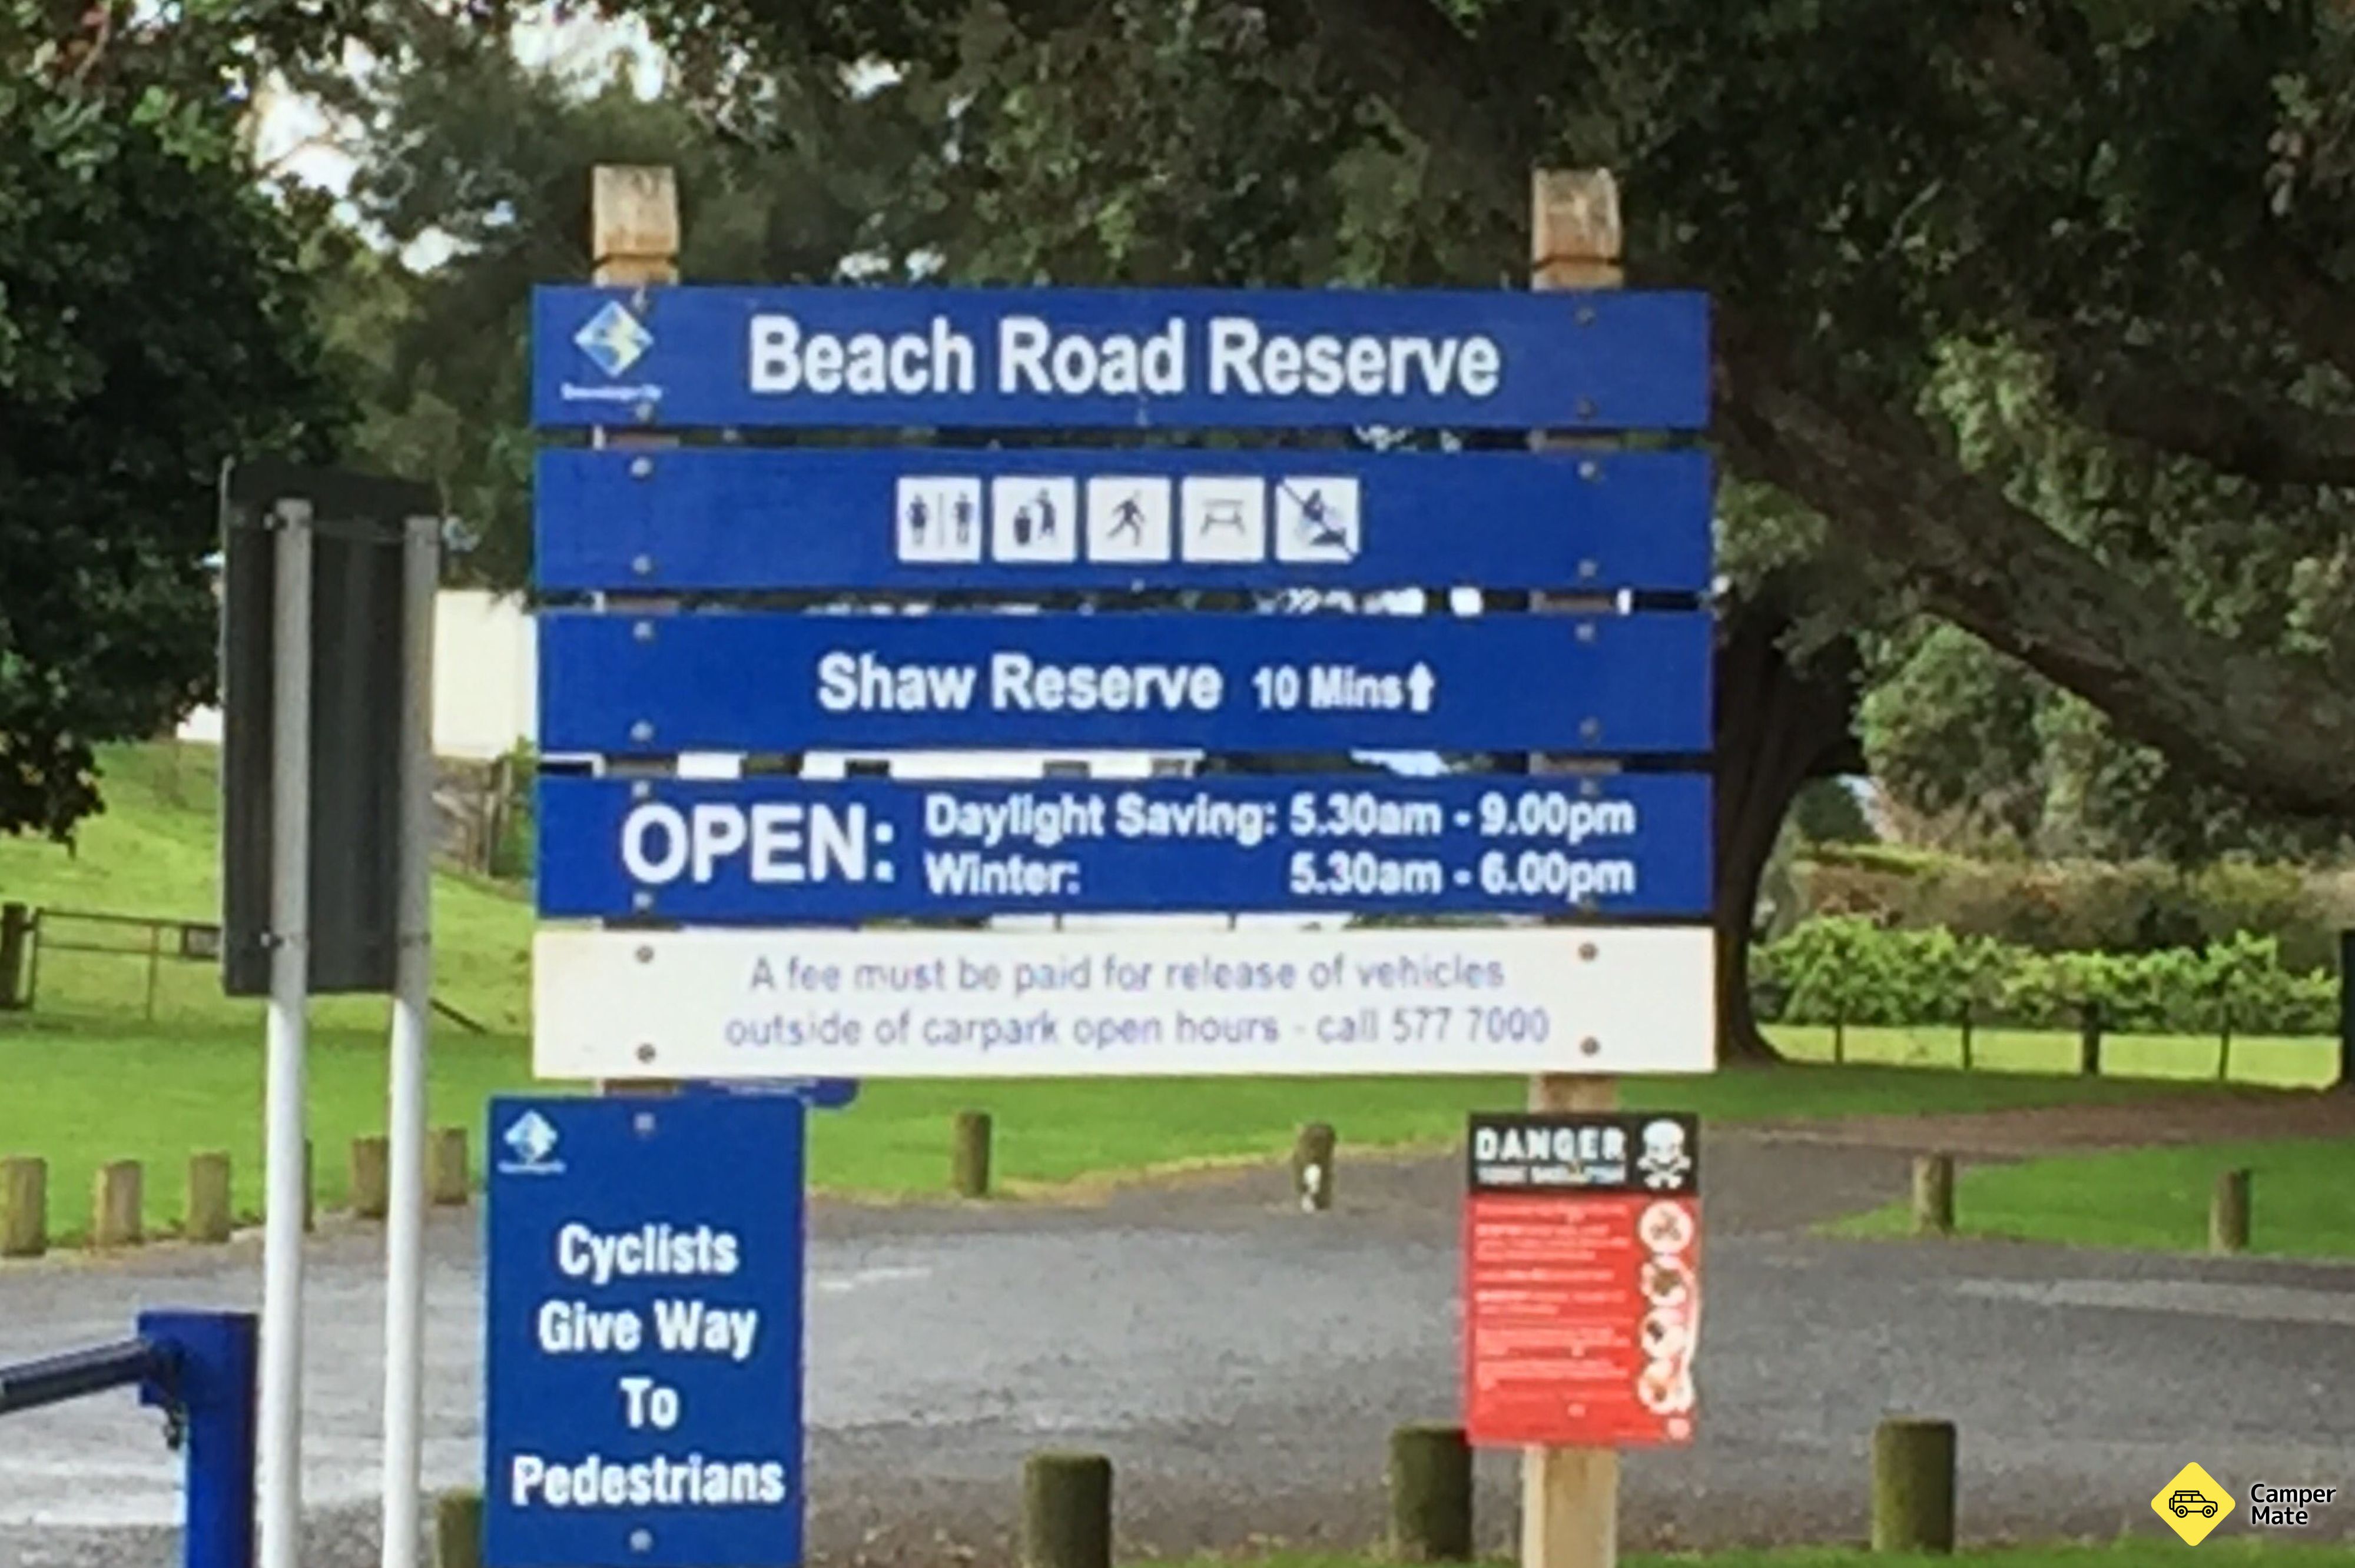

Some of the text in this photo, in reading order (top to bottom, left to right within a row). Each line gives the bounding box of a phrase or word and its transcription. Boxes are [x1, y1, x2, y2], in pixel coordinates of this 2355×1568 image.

[749, 314, 1500, 396] Beach Road Reserve
[818, 652, 1404, 711] Shaw Reserve 10 Mins
[622, 803, 894, 884] OPEN:
[925, 793, 1106, 846] Daylight
[1115, 791, 1277, 847] Saving:
[1289, 791, 1443, 837] 5.30am
[1480, 791, 1636, 845] 9.00pm
[924, 852, 1080, 896] Winter:
[1290, 850, 1443, 895] 5.30am
[1480, 850, 1636, 903] 6.00pm
[750, 951, 1505, 998] A fee must be paid for release of vehicles
[725, 1011, 862, 1048] outside
[874, 1008, 911, 1047] of
[922, 1009, 1058, 1052] carpark
[1072, 1016, 1163, 1051] open
[1175, 1010, 1281, 1044] hours
[1316, 1008, 1379, 1045] call
[1392, 1005, 1453, 1044] 577
[1466, 1005, 1550, 1044] 7000
[1475, 1127, 1626, 1162] DANGER
[559, 1223, 739, 1285] Cyclists
[538, 1300, 758, 1361] Give Way
[619, 1377, 679, 1429] To
[512, 1454, 786, 1506] Pedestrians
